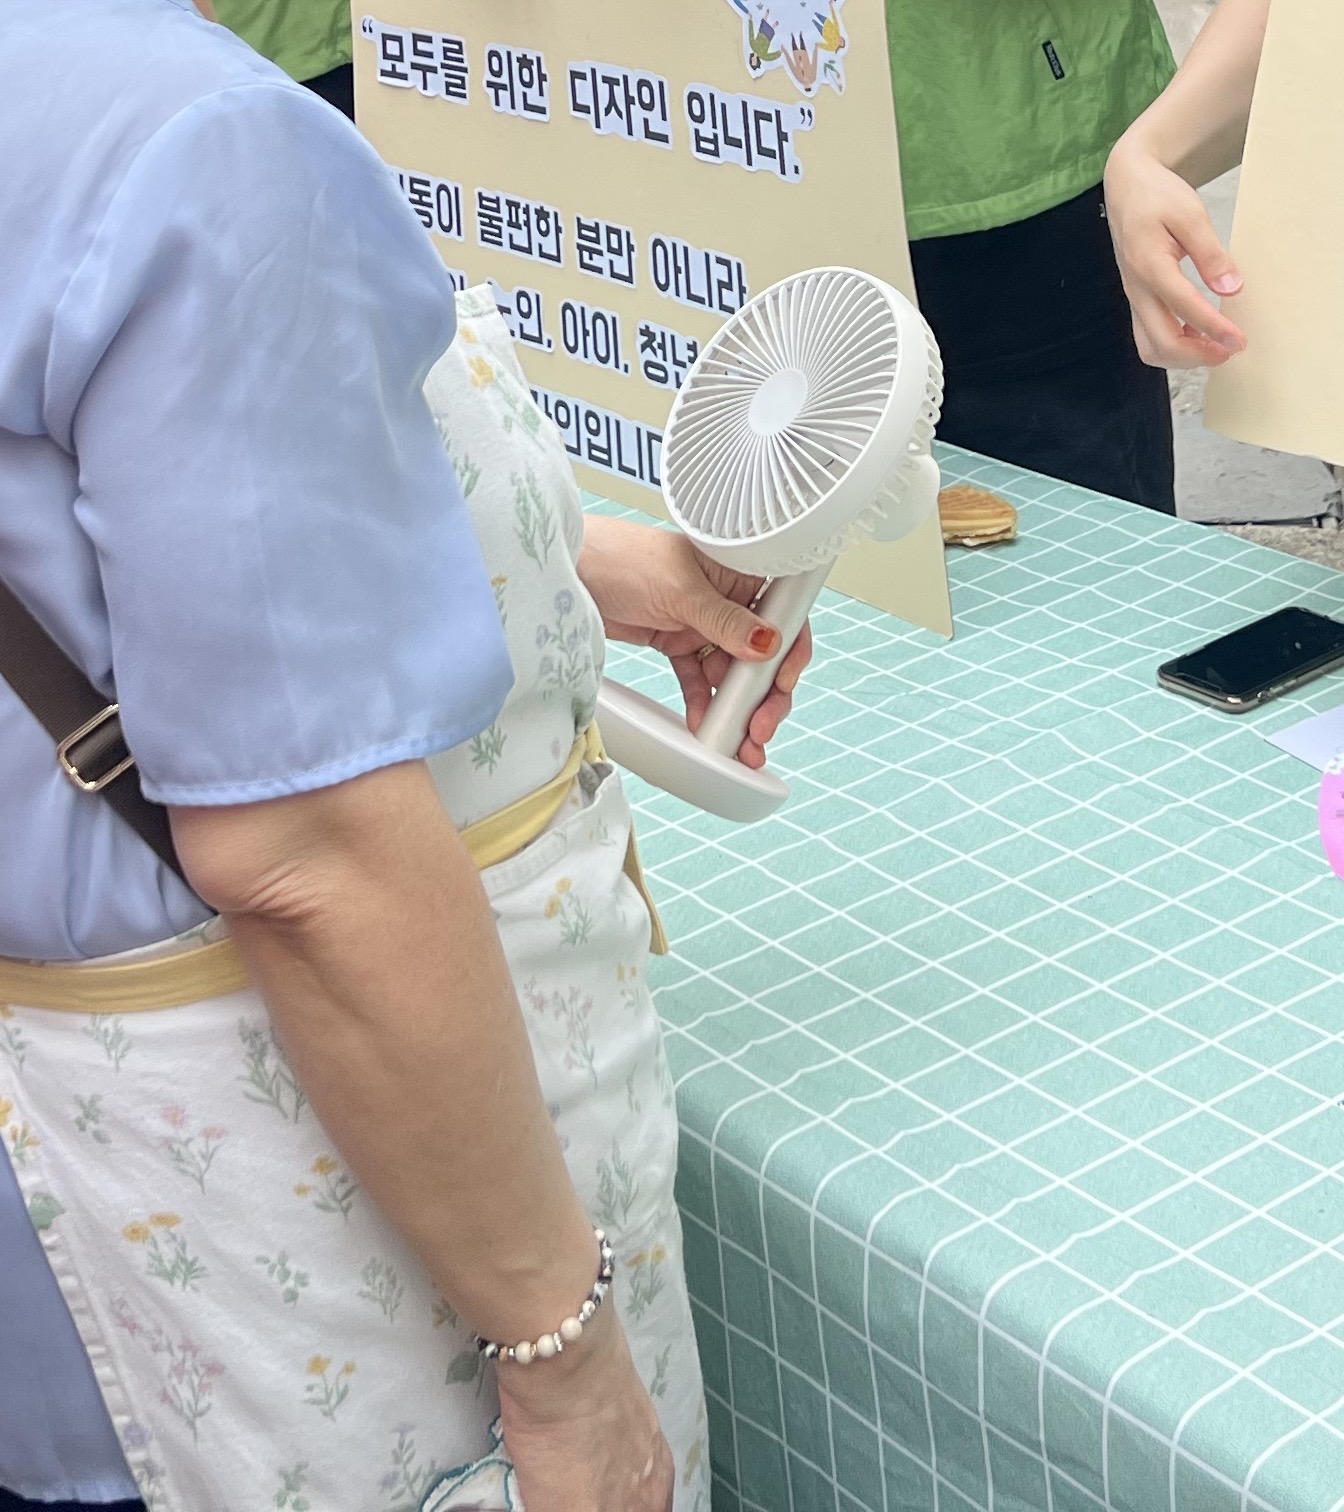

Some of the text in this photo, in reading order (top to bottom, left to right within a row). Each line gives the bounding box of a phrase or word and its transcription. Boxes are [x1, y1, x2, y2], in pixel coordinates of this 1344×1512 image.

[485, 48, 548, 116] 위한
[567, 63, 670, 144] 디자인
[399, 174, 747, 315] 동이 불편한 분만 아니라
